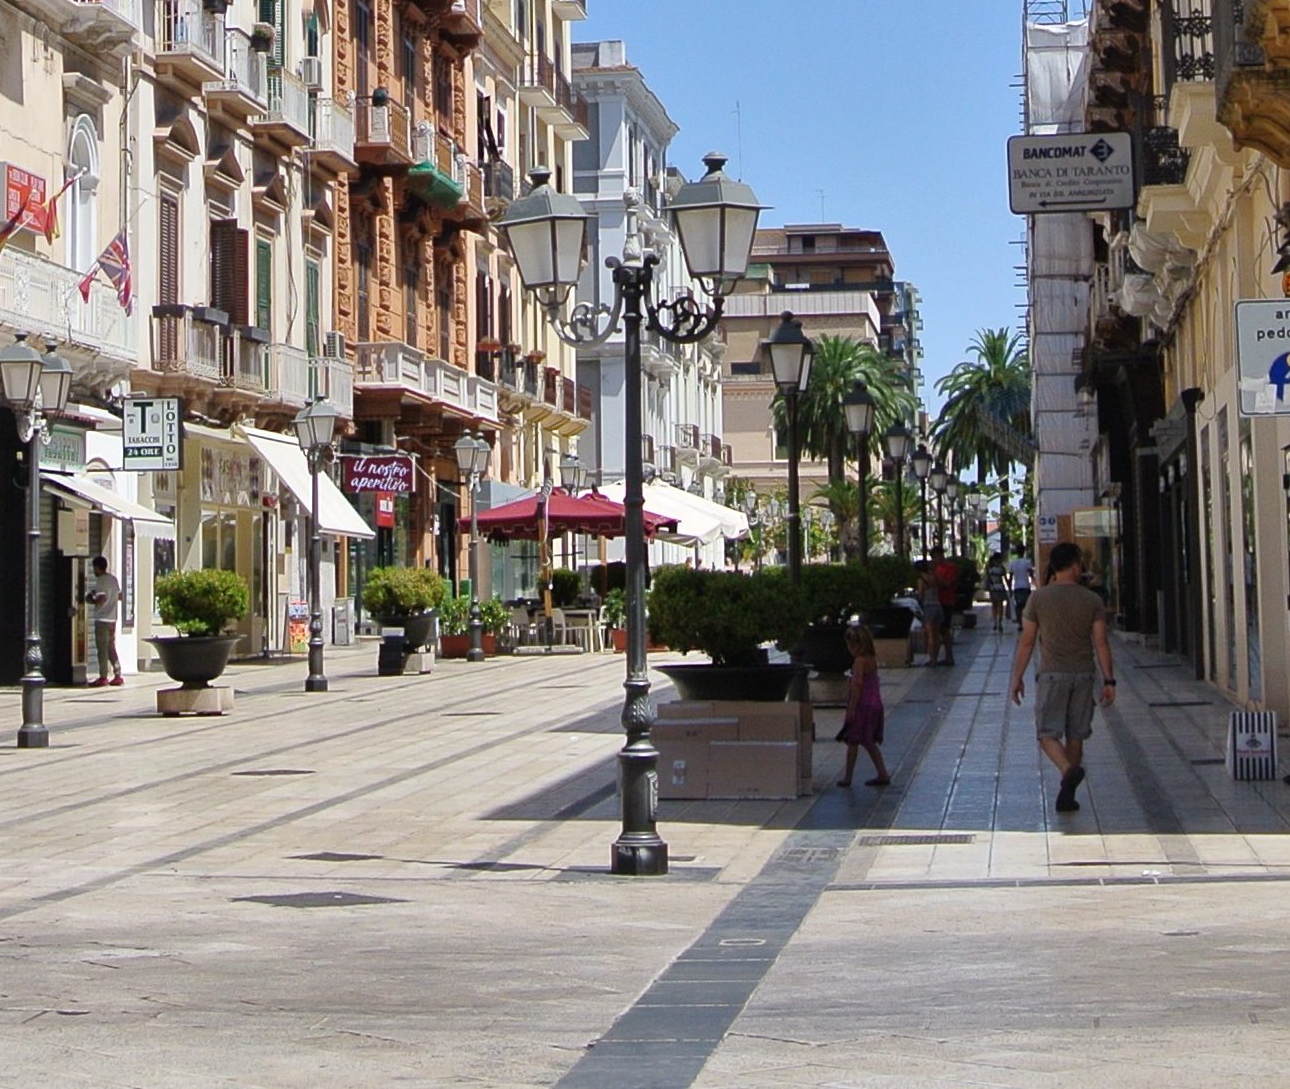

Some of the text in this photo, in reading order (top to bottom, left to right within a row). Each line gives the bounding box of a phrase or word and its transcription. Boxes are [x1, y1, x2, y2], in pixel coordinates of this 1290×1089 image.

[1023, 146, 1087, 159] BANCOMAT
[1013, 166, 1130, 179] BANCA DI TARANTO
[133, 402, 153, 434] T
[166, 401, 176, 454] LOTTO
[140, 448, 161, 456] ORE
[368, 461, 409, 477] nostro
[351, 477, 409, 493] aperitivo
